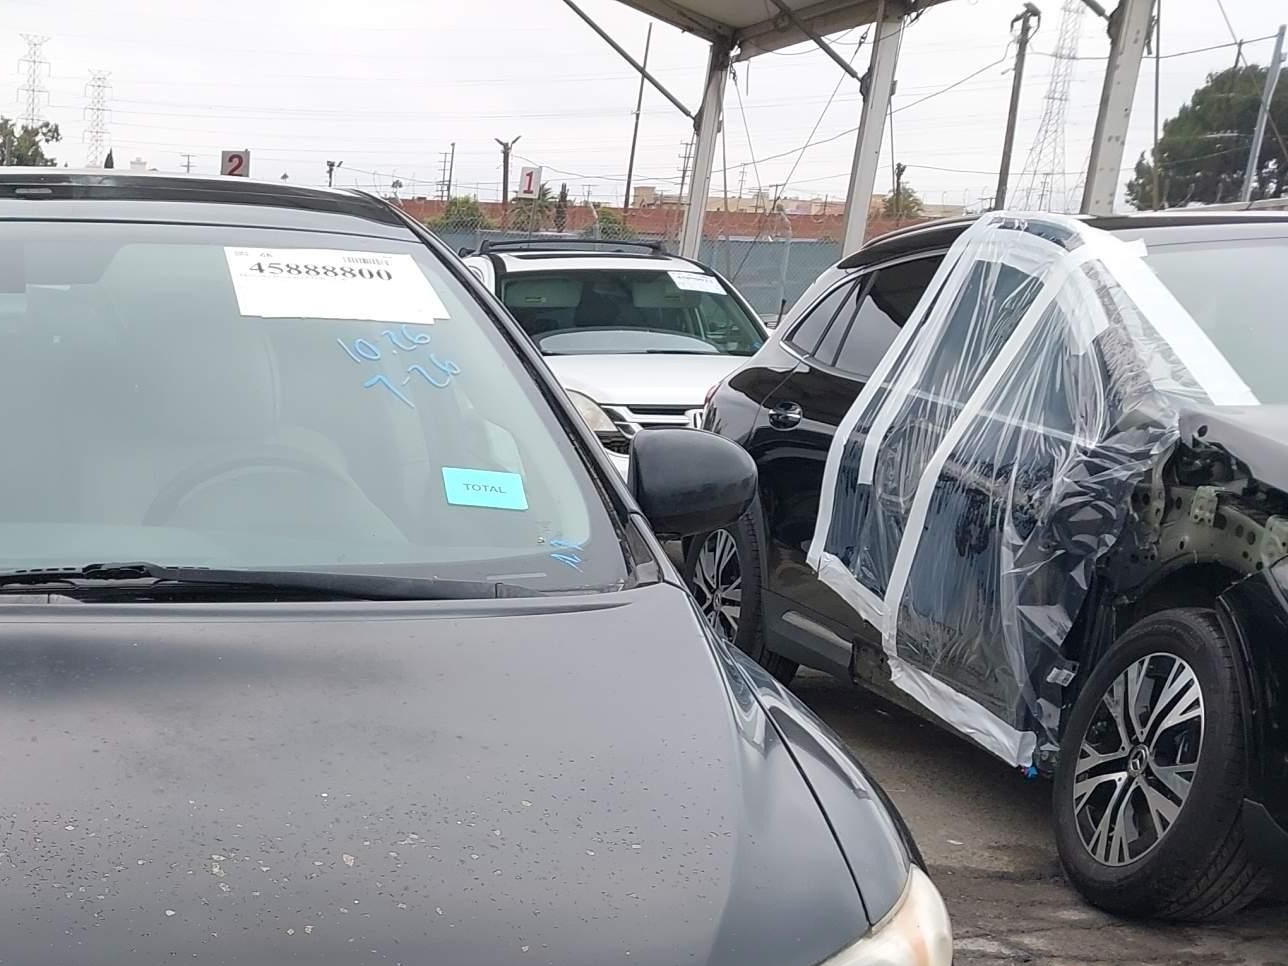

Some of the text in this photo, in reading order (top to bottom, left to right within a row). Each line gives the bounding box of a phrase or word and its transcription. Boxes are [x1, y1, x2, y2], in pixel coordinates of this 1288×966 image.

[227, 153, 244, 177] 2
[523, 170, 534, 194] 1
[248, 261, 393, 281] 45888800
[463, 483, 507, 494] TOTAL
